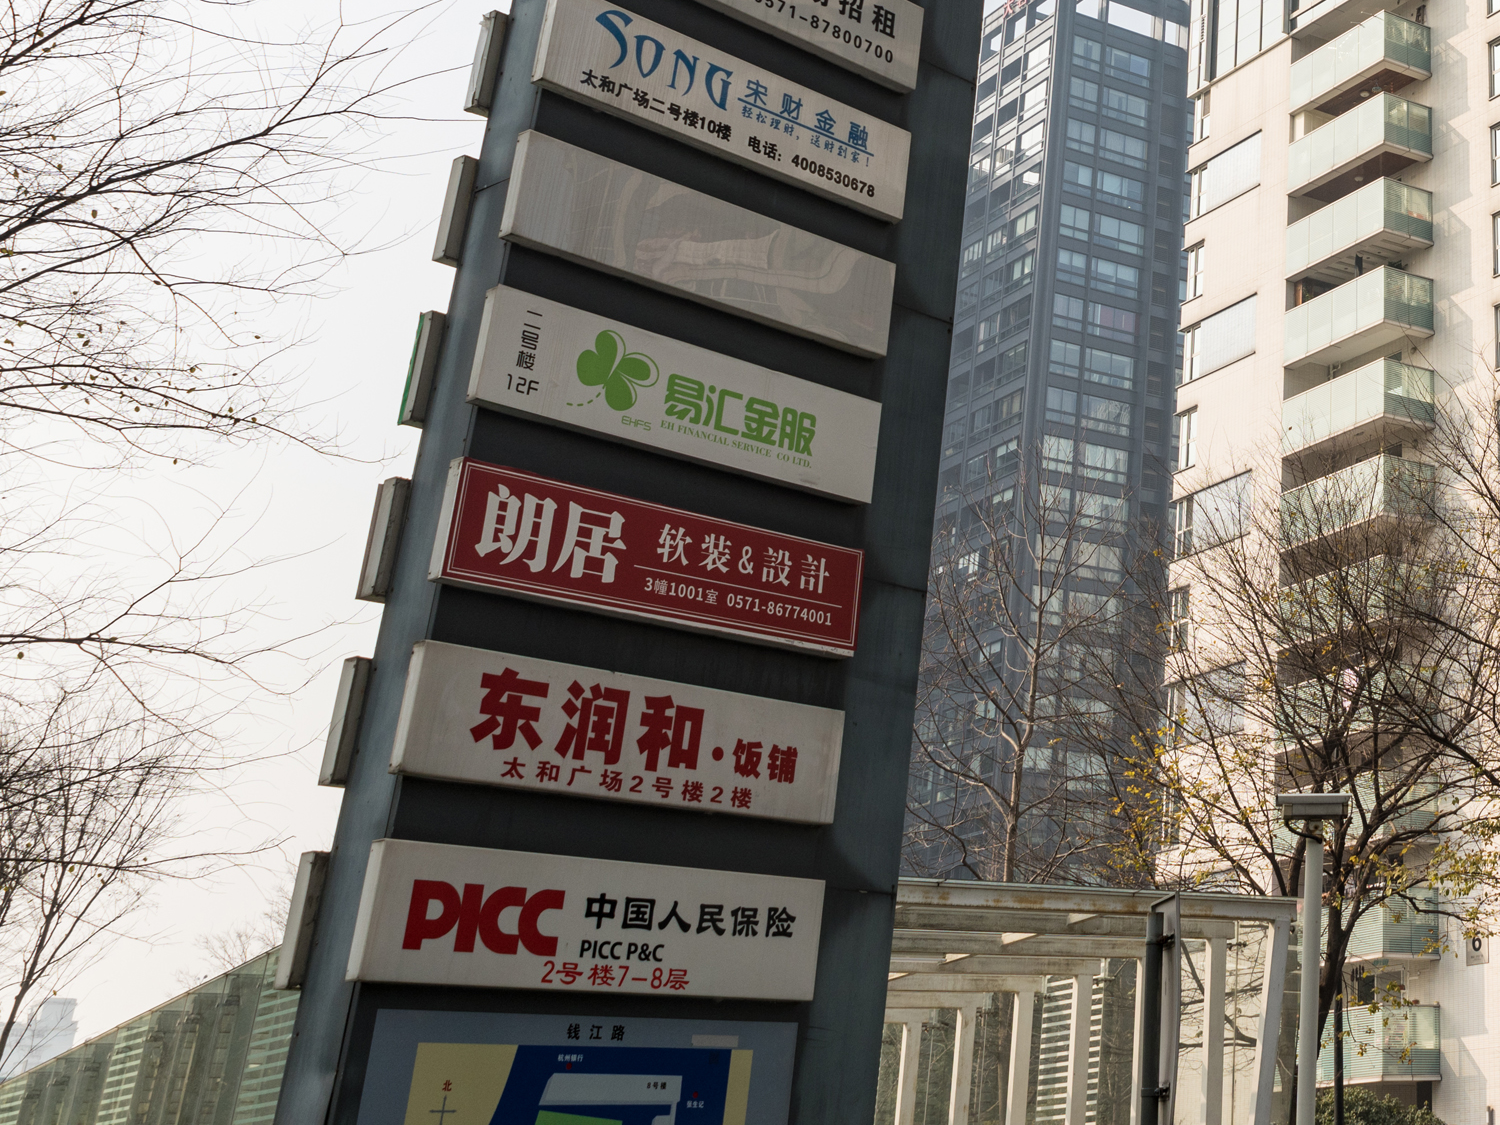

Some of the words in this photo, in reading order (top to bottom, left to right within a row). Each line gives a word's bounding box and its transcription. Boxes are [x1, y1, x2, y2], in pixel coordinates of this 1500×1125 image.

[580, 69, 732, 142] 太和广场二号楼10楼
[743, 79, 869, 151] 宋财金融
[515, 310, 543, 371] 二号楼
[507, 373, 540, 395] 12F
[621, 415, 652, 431] EHFS
[664, 373, 817, 457] 易汇金服
[660, 419, 675, 431] EH
[677, 424, 729, 447] FINANCIAL
[731, 439, 772, 458] SERVICE
[776, 451, 790, 462] CO
[792, 455, 812, 469] LTD.
[474, 483, 627, 583] 朗居
[643, 577, 719, 605] 3幢1001室
[726, 592, 833, 626] 0571-86774001
[500, 756, 753, 809] 太和广场2号楼2楼
[402, 879, 566, 957] PICC
[584, 893, 797, 939] 中国人民保险
[540, 960, 690, 991] 2号楼7-8层
[579, 939, 622, 960] PICC
[626, 942, 665, 963] P&C
[566, 1022, 626, 1041] 钱江路
[441, 1080, 453, 1092] 北
